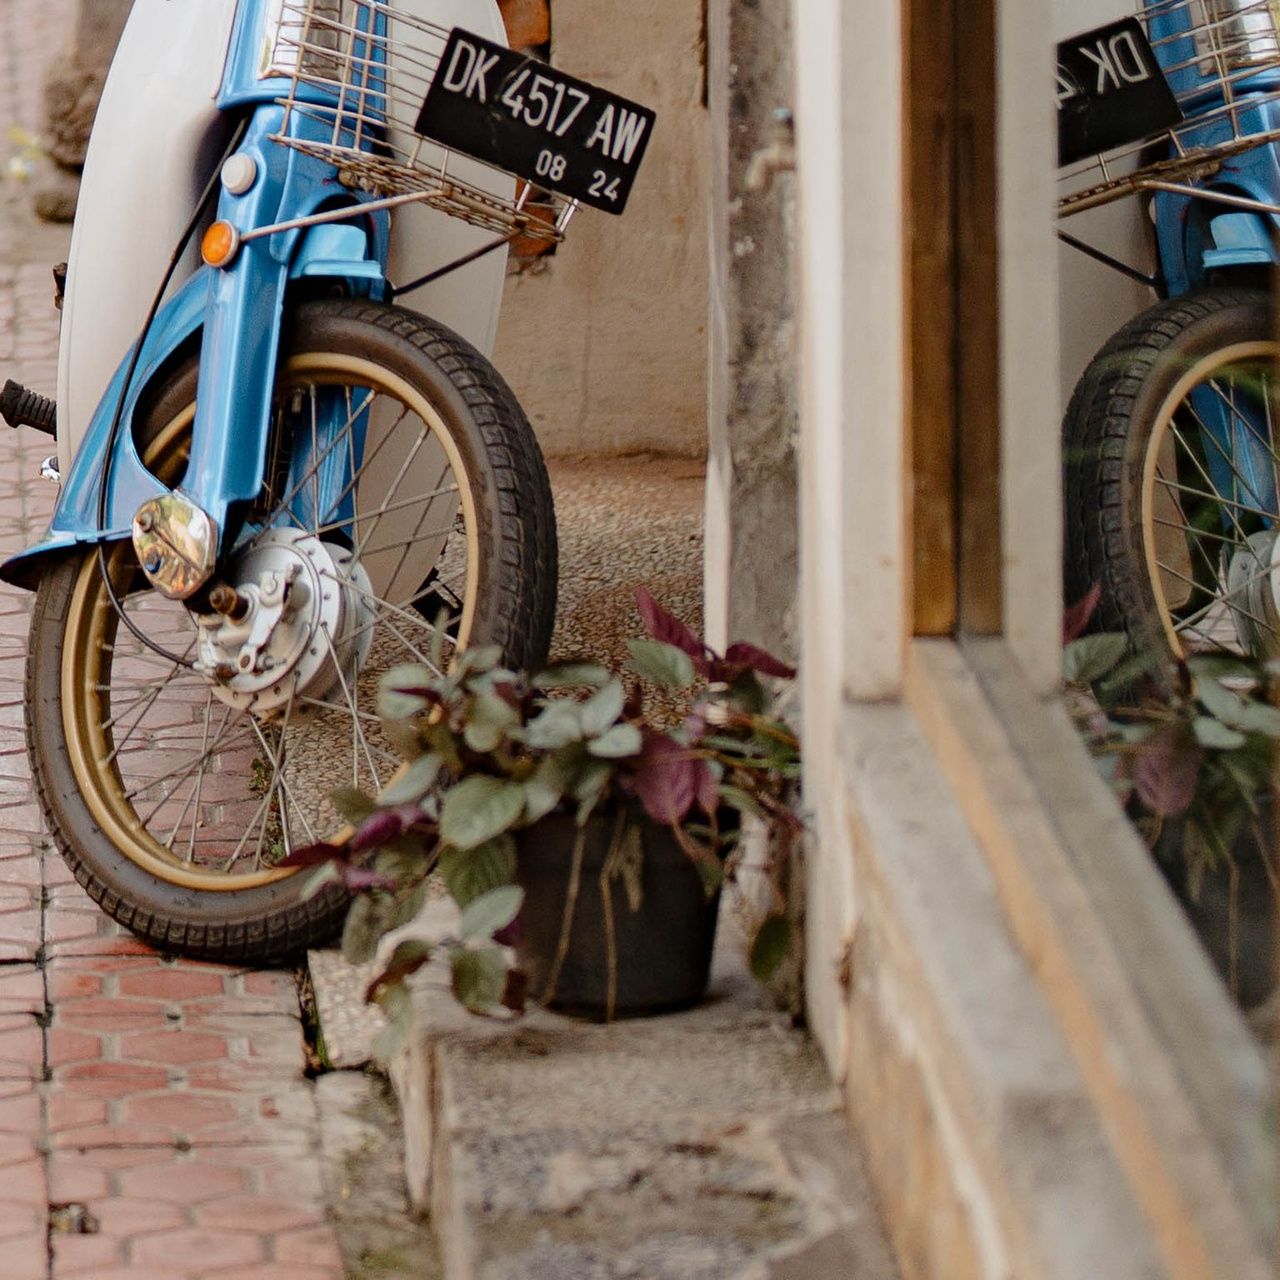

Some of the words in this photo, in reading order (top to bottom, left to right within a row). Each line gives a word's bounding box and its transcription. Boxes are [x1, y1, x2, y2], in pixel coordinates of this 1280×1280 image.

[442, 39, 500, 104] DK
[501, 69, 590, 137] 4517
[585, 103, 648, 165] AW
[534, 149, 568, 182] 08
[587, 170, 624, 202] 24
